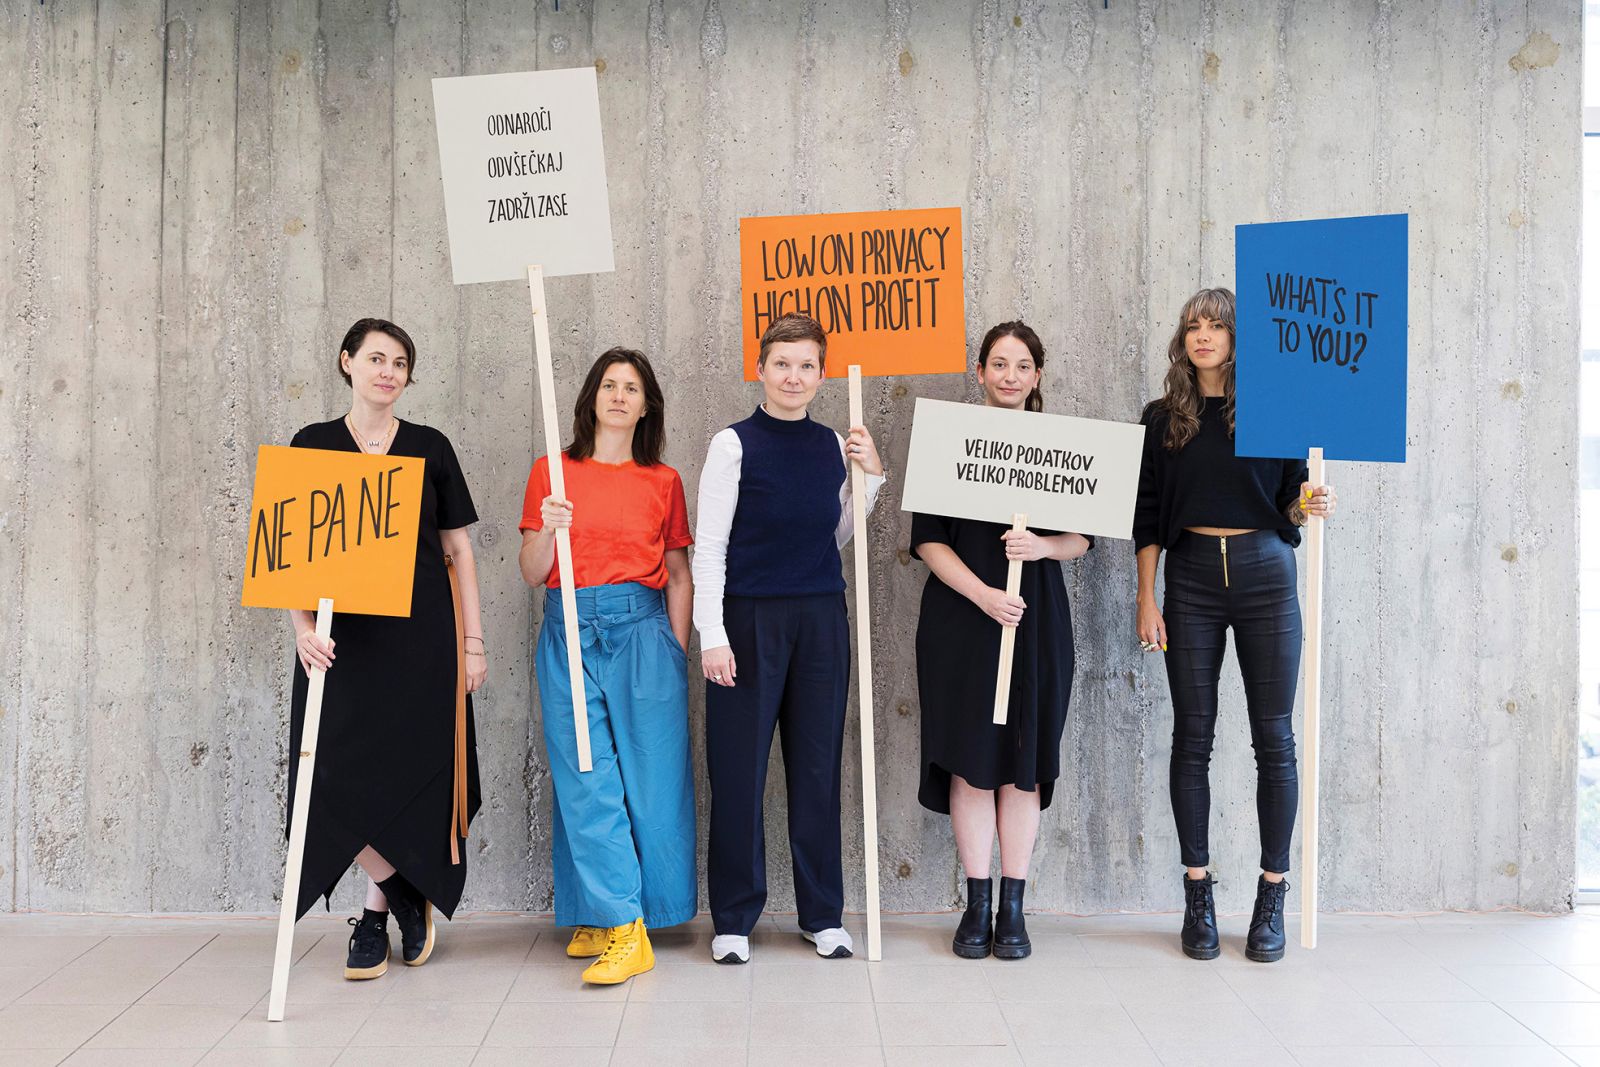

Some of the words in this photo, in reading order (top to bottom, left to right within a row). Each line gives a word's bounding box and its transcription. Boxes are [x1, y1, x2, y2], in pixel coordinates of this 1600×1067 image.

[487, 106, 552, 136] ODNAROČI
[487, 149, 563, 178] ODVŠEČKAJ
[762, 235, 816, 282] LOW
[820, 232, 854, 276] ON
[862, 226, 950, 275] PRIVACY
[816, 284, 853, 334] ON
[862, 278, 940, 331] PROFIT
[1266, 272, 1346, 325] WHAT'S
[1356, 292, 1379, 329] IT
[1272, 317, 1300, 353] TO
[1307, 324, 1367, 374] YOU?
[956, 462, 1006, 485] VELIKO
[1008, 468, 1098, 495] PROBLEMOV
[965, 438, 1012, 461] VELIKO
[1016, 445, 1094, 471] PODATKOV
[251, 497, 296, 578] NE
[308, 483, 346, 562] PA
[357, 466, 403, 546] NE
